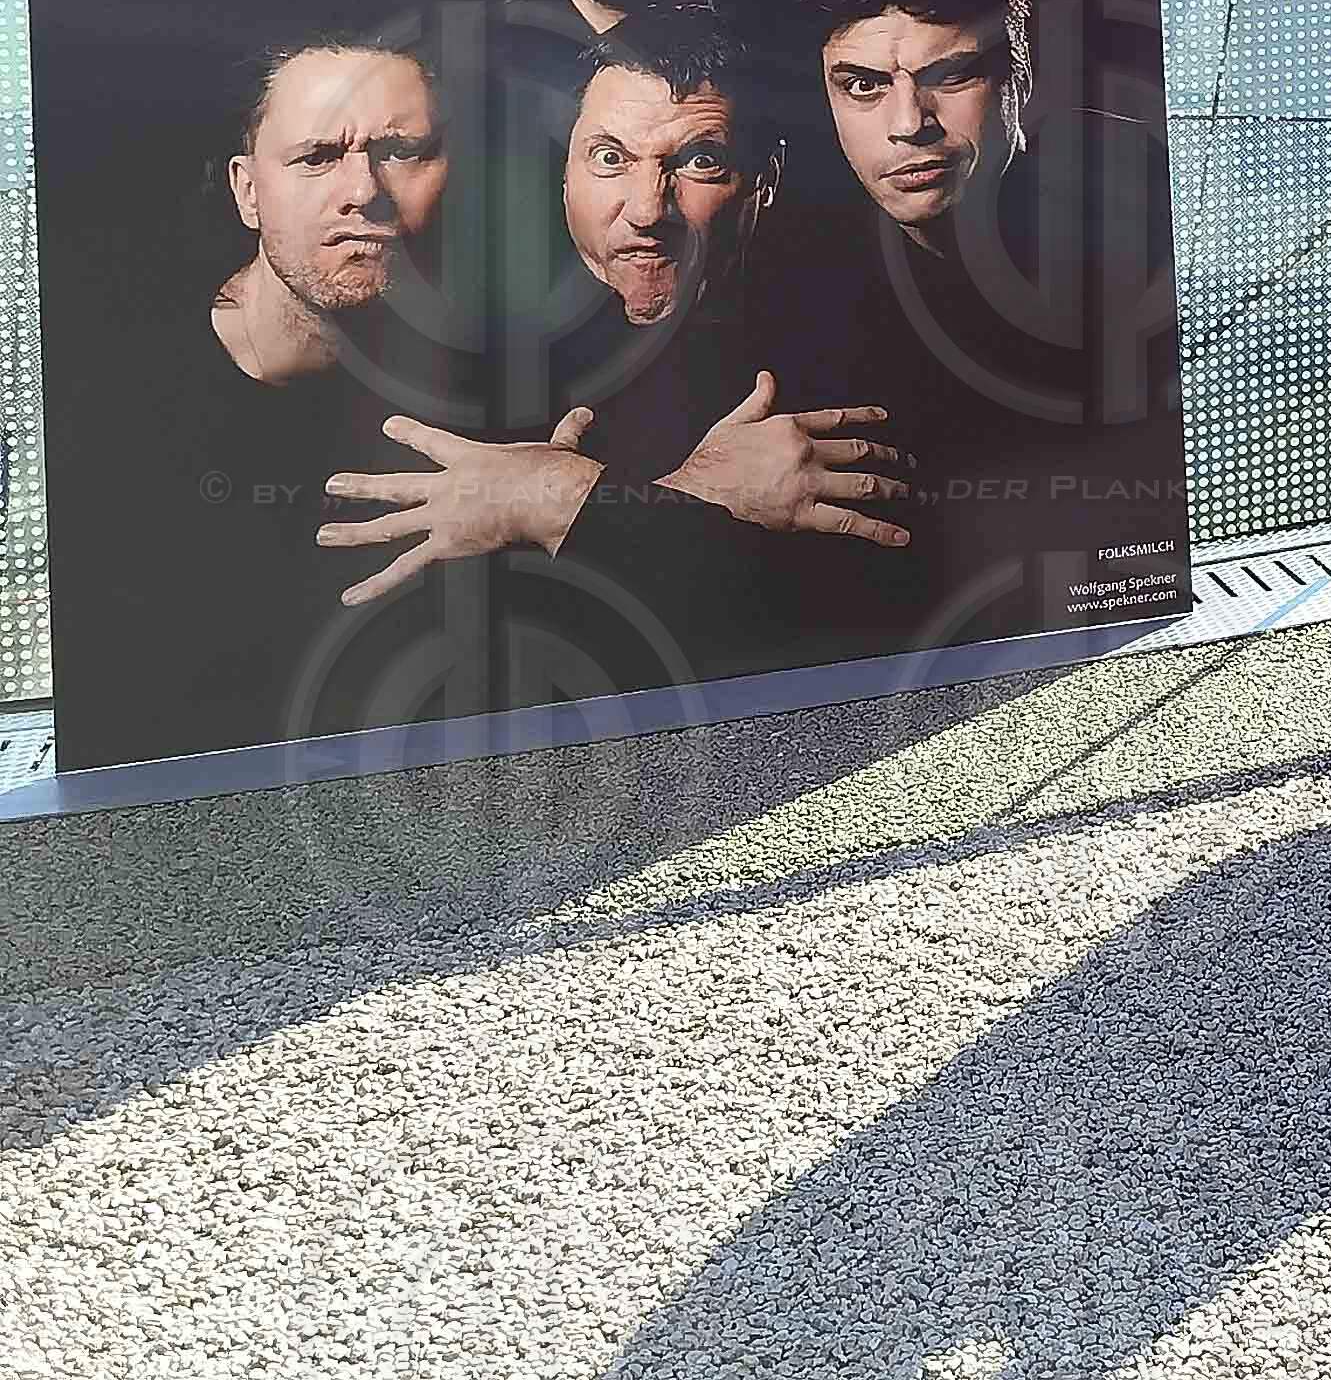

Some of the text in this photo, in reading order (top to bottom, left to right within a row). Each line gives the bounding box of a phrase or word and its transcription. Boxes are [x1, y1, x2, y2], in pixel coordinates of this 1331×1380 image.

[1098, 540, 1175, 560] FOLKSMILCH
[1068, 573, 1177, 597] Wolfgang Spekner
[1066, 589, 1177, 614] www.spekner.com
